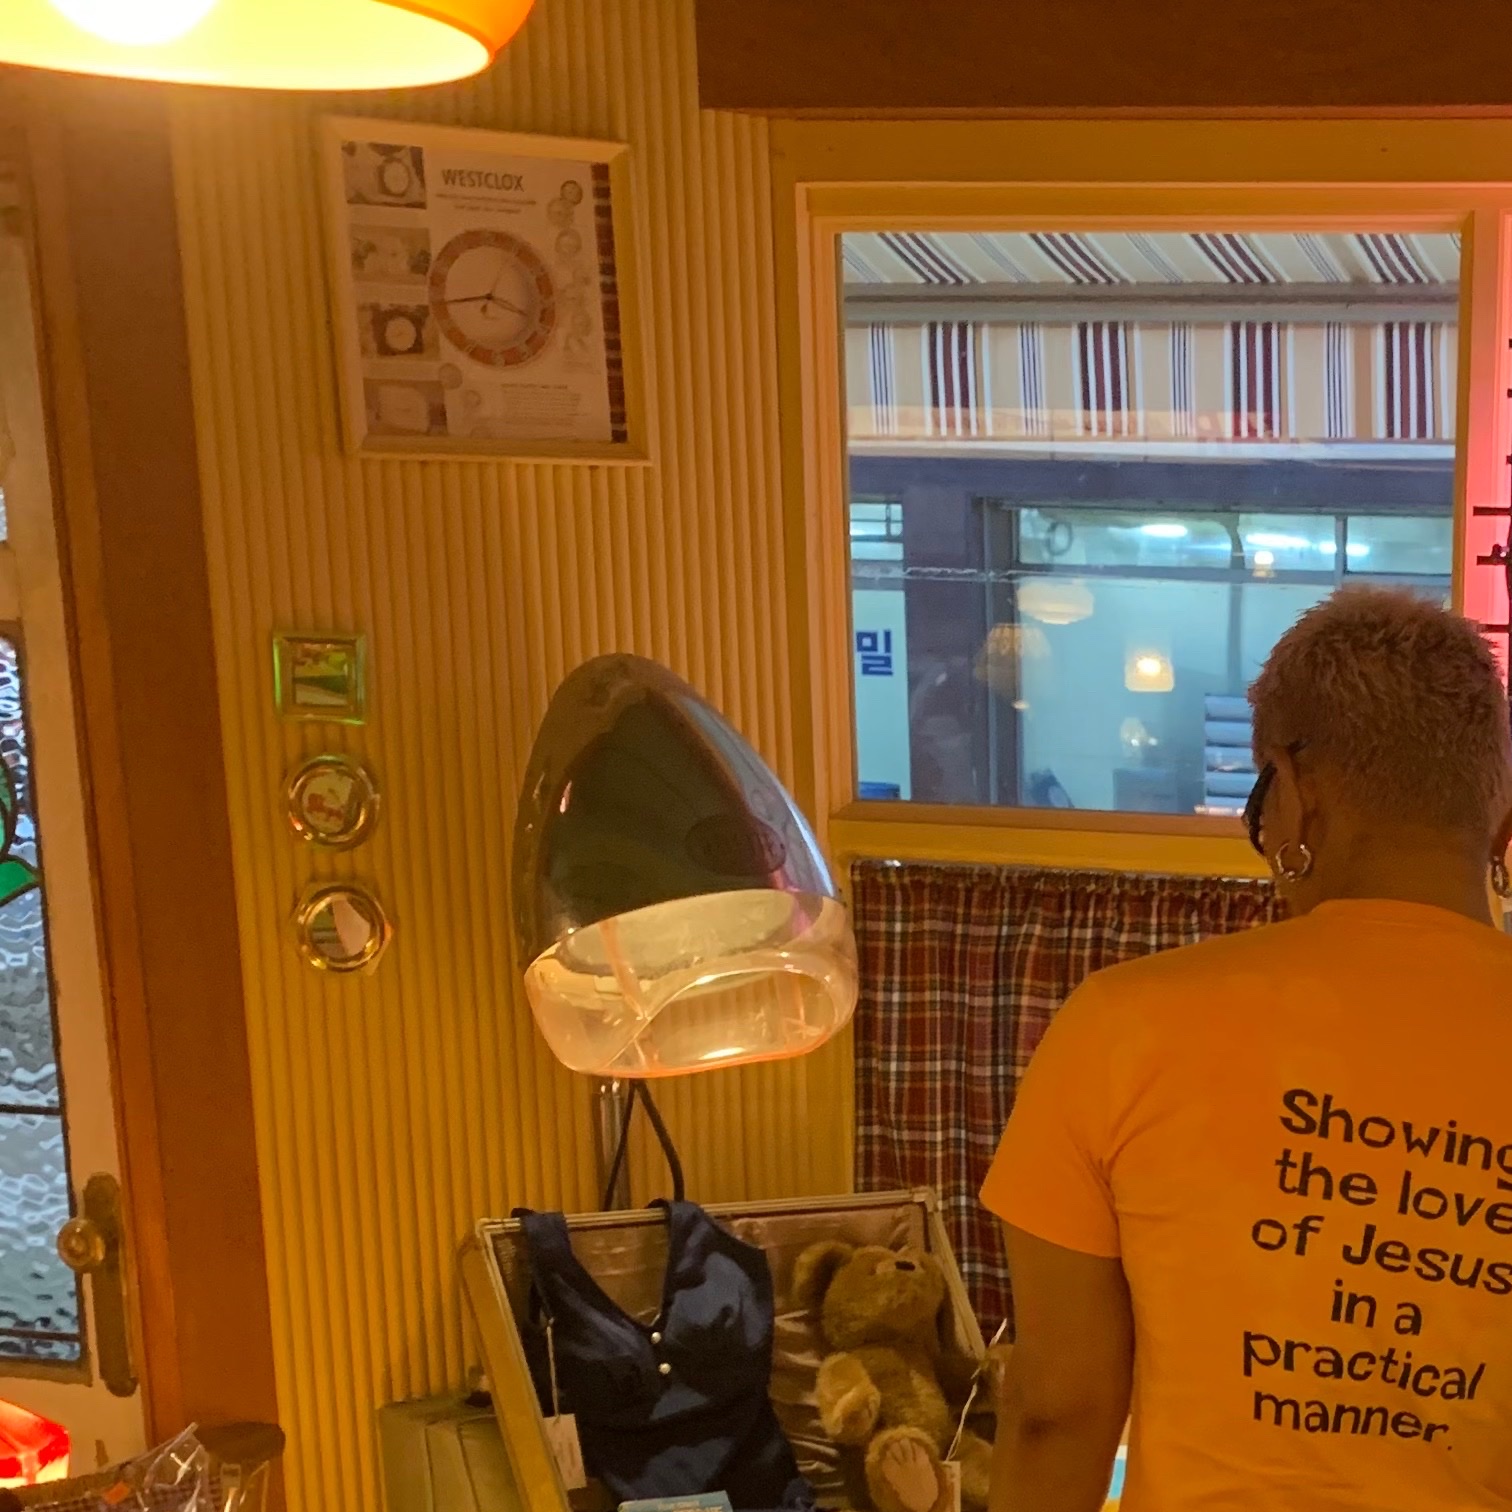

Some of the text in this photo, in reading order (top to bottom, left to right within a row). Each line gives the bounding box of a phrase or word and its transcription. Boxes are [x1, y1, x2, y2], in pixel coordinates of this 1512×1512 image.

[441, 168, 524, 192] WESTCLOX
[856, 629, 893, 676] 밀
[1274, 1148, 1378, 1206] the
[1251, 1215, 1325, 1257] of
[1330, 1279, 1423, 1337] in a
[1243, 1330, 1486, 1400] practical
[1253, 1390, 1453, 1451] manner.
